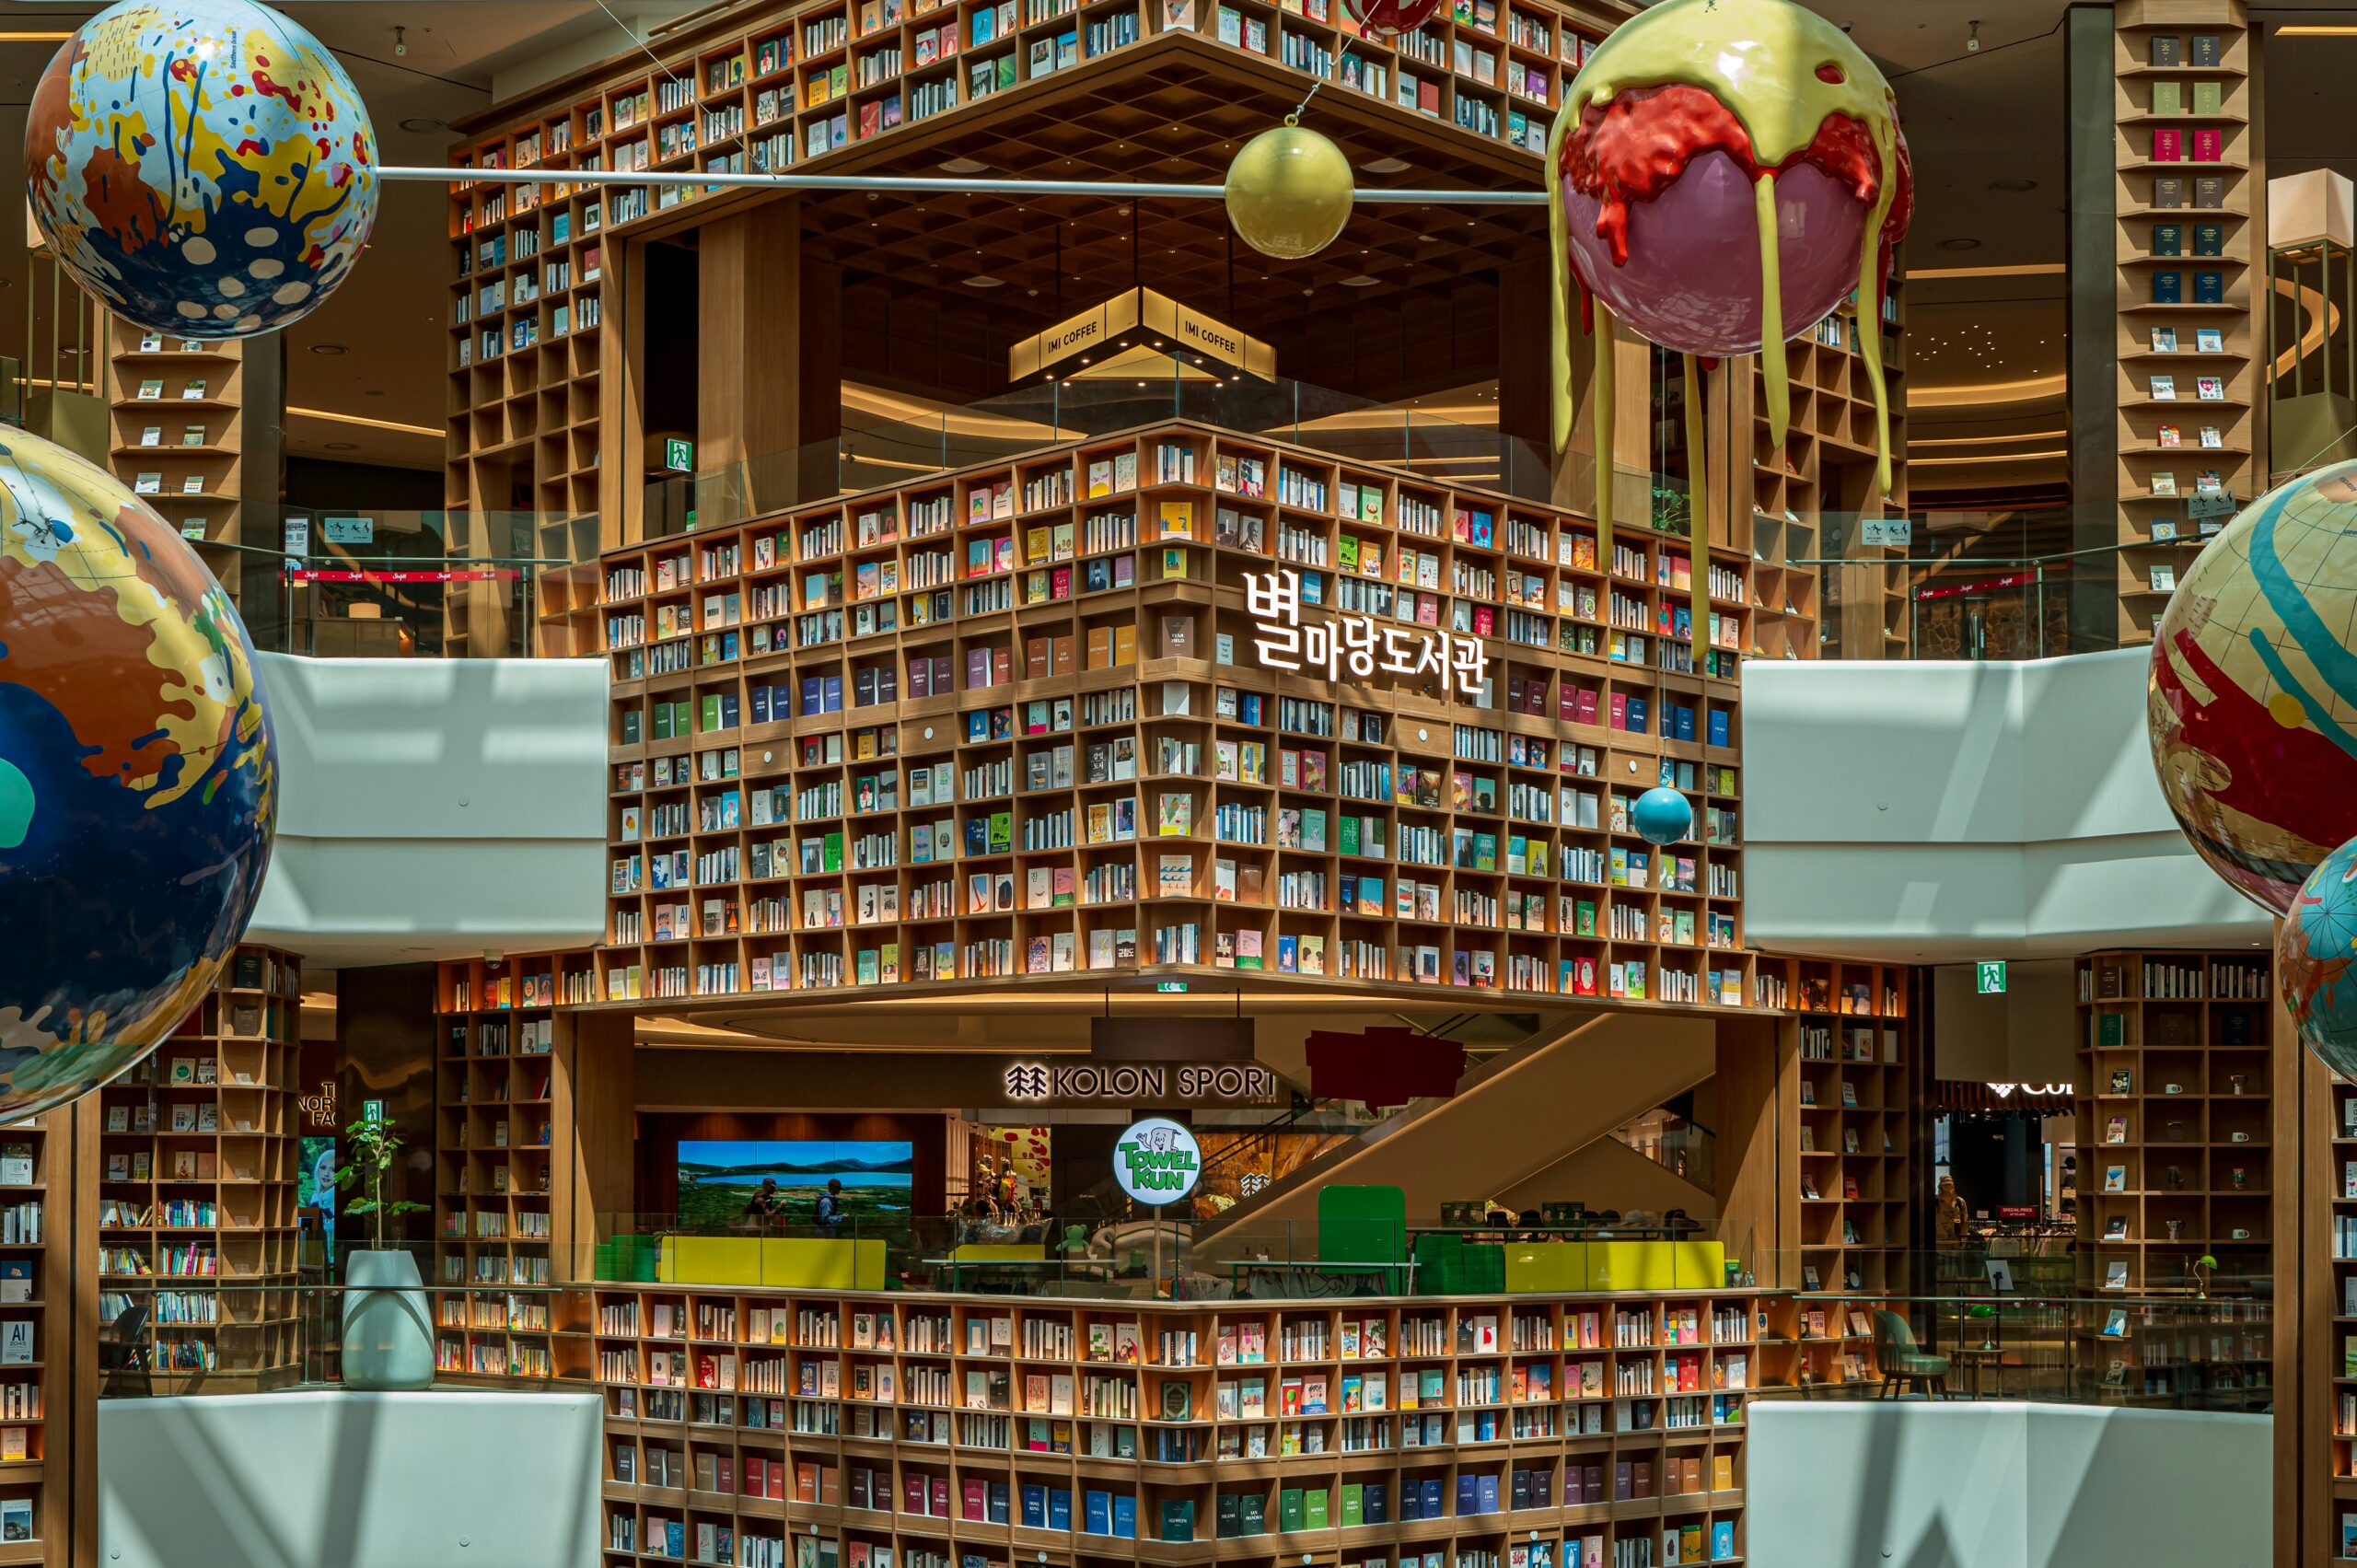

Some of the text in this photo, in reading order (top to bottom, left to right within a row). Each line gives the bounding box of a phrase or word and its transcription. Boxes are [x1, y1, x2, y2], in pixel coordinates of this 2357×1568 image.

[1048, 320, 1097, 354] IMI COFFEE
[1185, 319, 1236, 354] IMI COFFEE
[1240, 569, 1490, 694] 별마당도서관
[321, 1082, 336, 1098] T
[1053, 1068, 1276, 1096] KOLON SPORT
[298, 1097, 336, 1111] NOR
[312, 1111, 336, 1126] FA
[1119, 1141, 1198, 1170] TOWEL
[1132, 1165, 1185, 1190] KUN
[12, 1323, 26, 1342] AI
